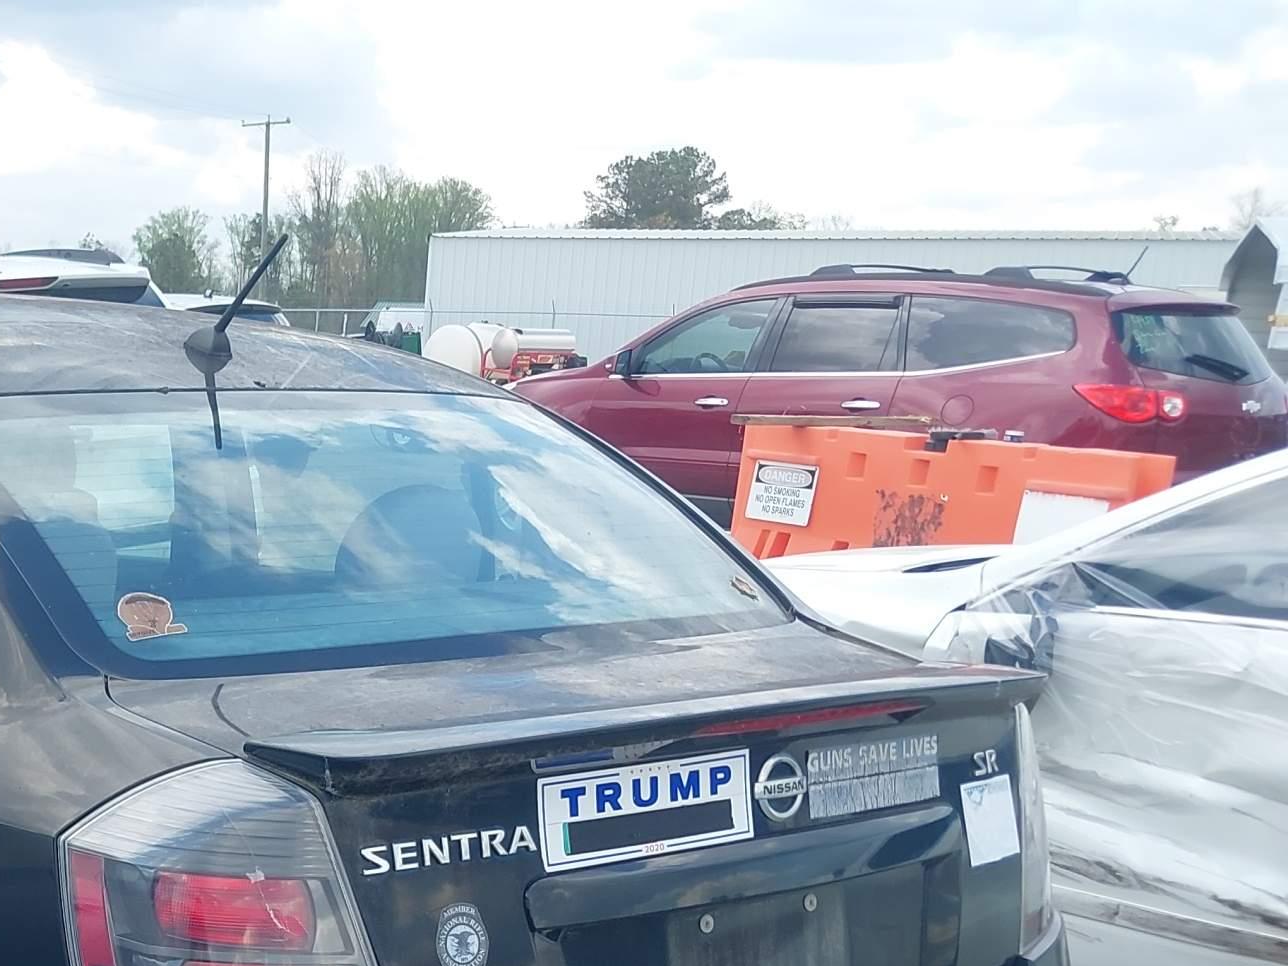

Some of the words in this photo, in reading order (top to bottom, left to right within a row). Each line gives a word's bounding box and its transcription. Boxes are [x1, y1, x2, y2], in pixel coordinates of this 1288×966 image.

[765, 469, 805, 484] DANGER
[764, 486, 772, 494] NO
[774, 487, 800, 498] SMOKING
[755, 495, 764, 503] NO
[765, 496, 780, 505] OPEN
[781, 498, 806, 509] FLAMES
[762, 505, 771, 513] NO
[772, 506, 794, 516] SPARKS
[807, 747, 852, 772] GUNS
[859, 741, 897, 765] SAVE
[902, 735, 938, 758] LIVES
[973, 749, 999, 776] SR
[560, 765, 733, 817] TRUMP
[763, 780, 804, 795] NISSAN
[359, 825, 538, 876] SENTRA
[644, 842, 665, 853] 2020
[443, 905, 476, 918] MEMBER
[439, 916, 469, 946] NATIONAL
[469, 917, 486, 941] RIFLE
